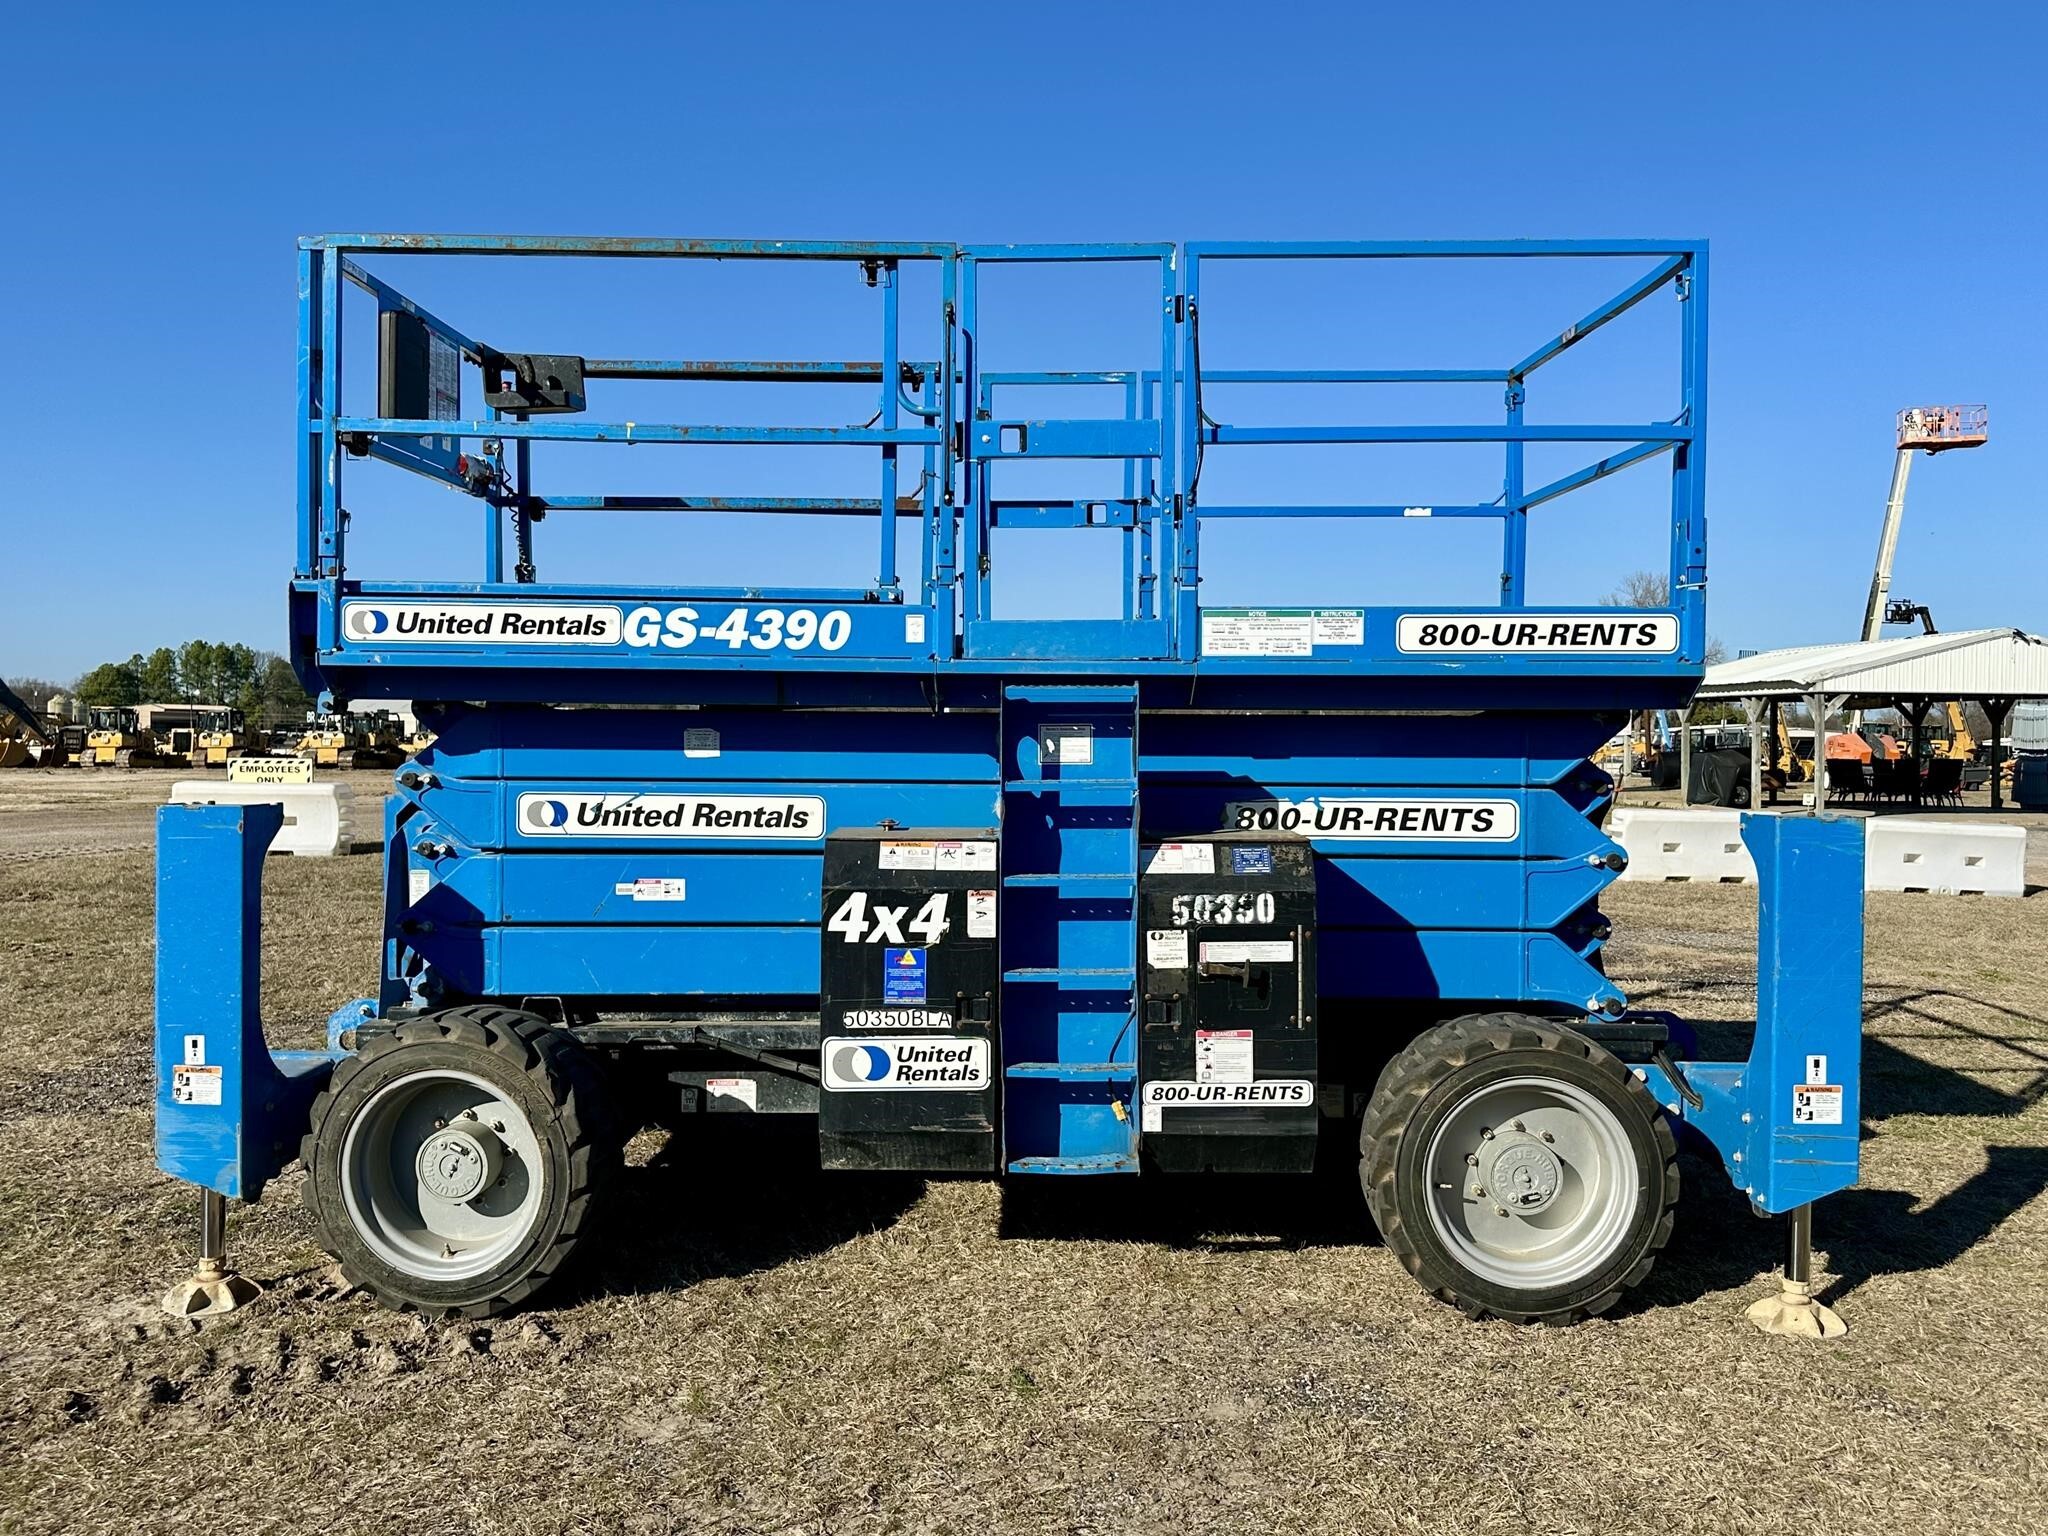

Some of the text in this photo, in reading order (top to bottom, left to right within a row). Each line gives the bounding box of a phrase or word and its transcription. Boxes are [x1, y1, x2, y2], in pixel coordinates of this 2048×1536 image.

[396, 612, 607, 636] United Rentals
[623, 606, 852, 651] GS-4390
[1418, 623, 1658, 646] 800-UR-RENTS
[577, 802, 809, 828] United Rentals
[1235, 807, 1494, 832] 800-UR-RENTS
[827, 891, 950, 944] 4x4
[843, 1010, 951, 1027] 50350BLA
[896, 1046, 973, 1062] United
[896, 1065, 980, 1081] Rentals
[1151, 1085, 1304, 1100] 800-UR-RENTS
